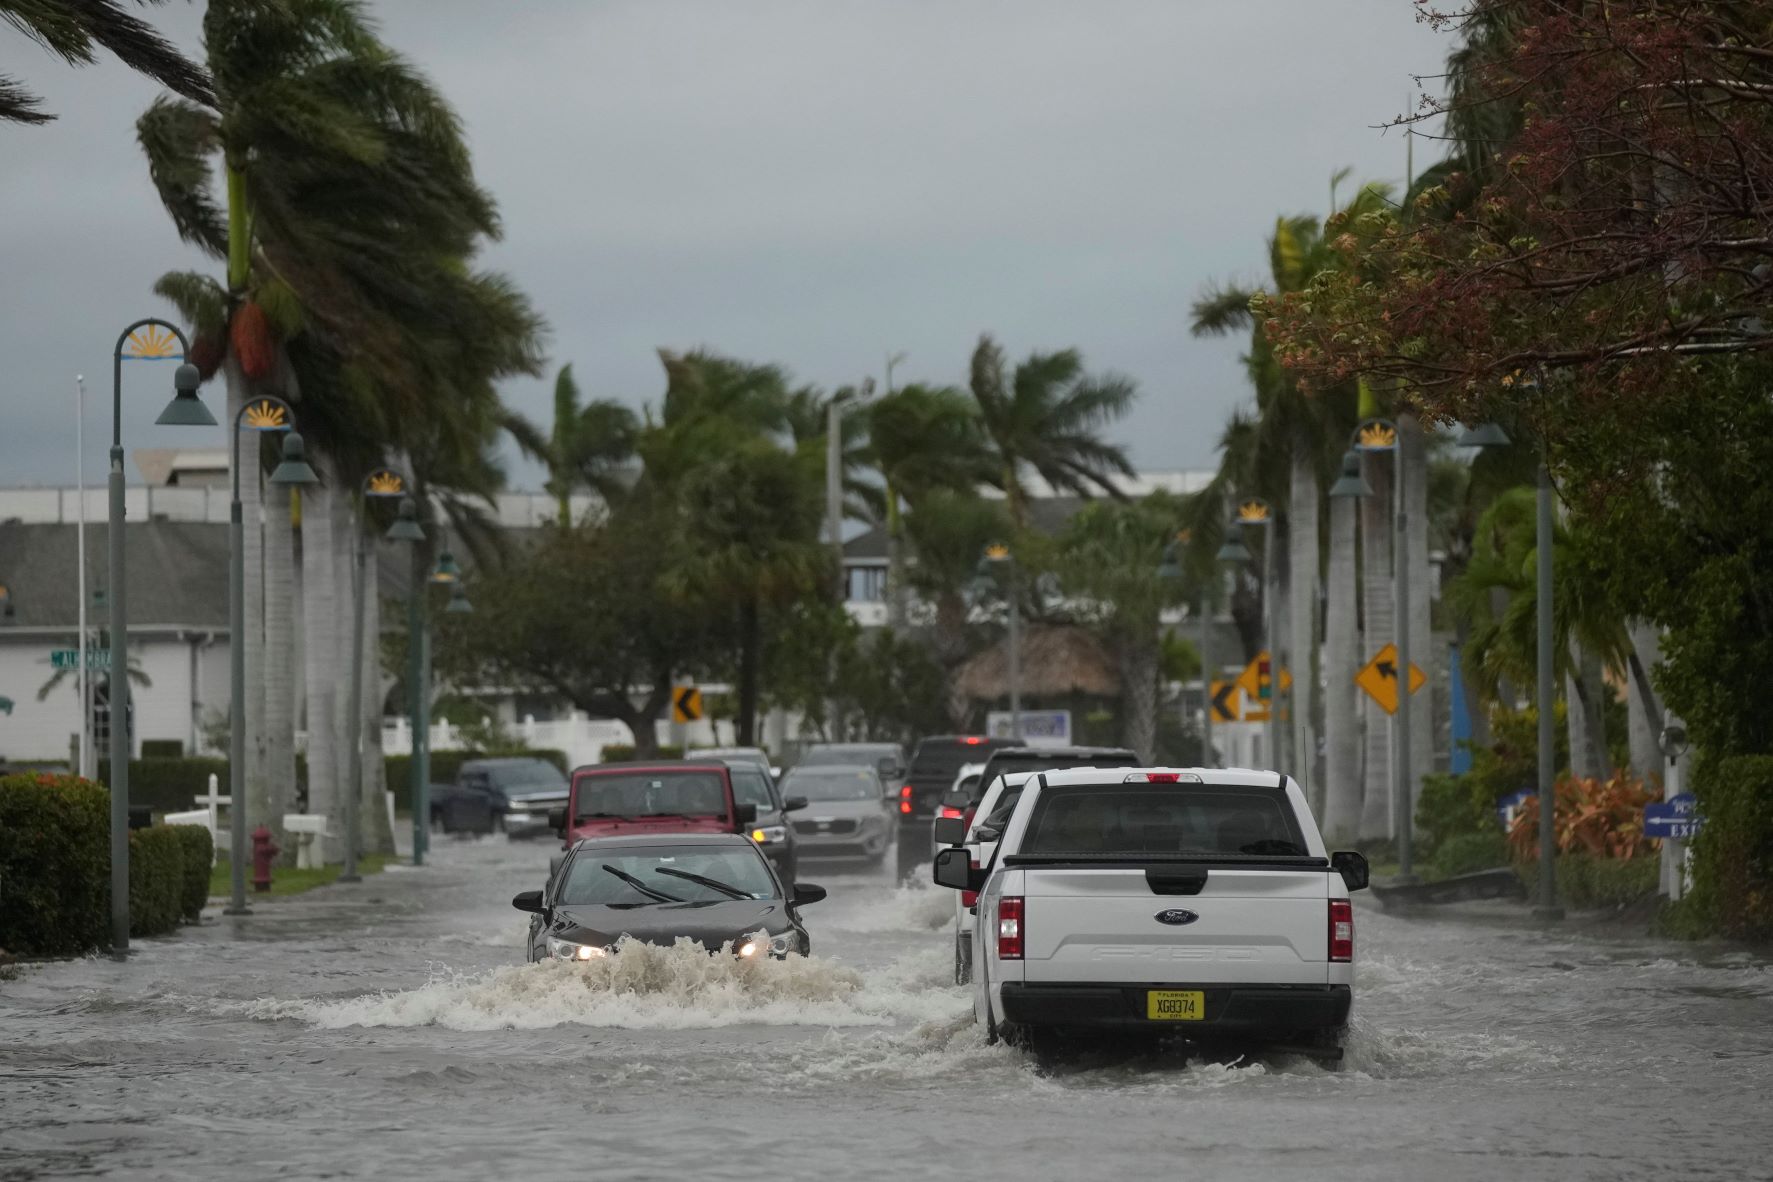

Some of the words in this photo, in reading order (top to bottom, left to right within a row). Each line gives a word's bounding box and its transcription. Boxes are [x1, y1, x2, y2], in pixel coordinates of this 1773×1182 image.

[1671, 824, 1698, 838] EXI
[1164, 910, 1189, 922] Ford
[1157, 999, 1195, 1014] XG8374
